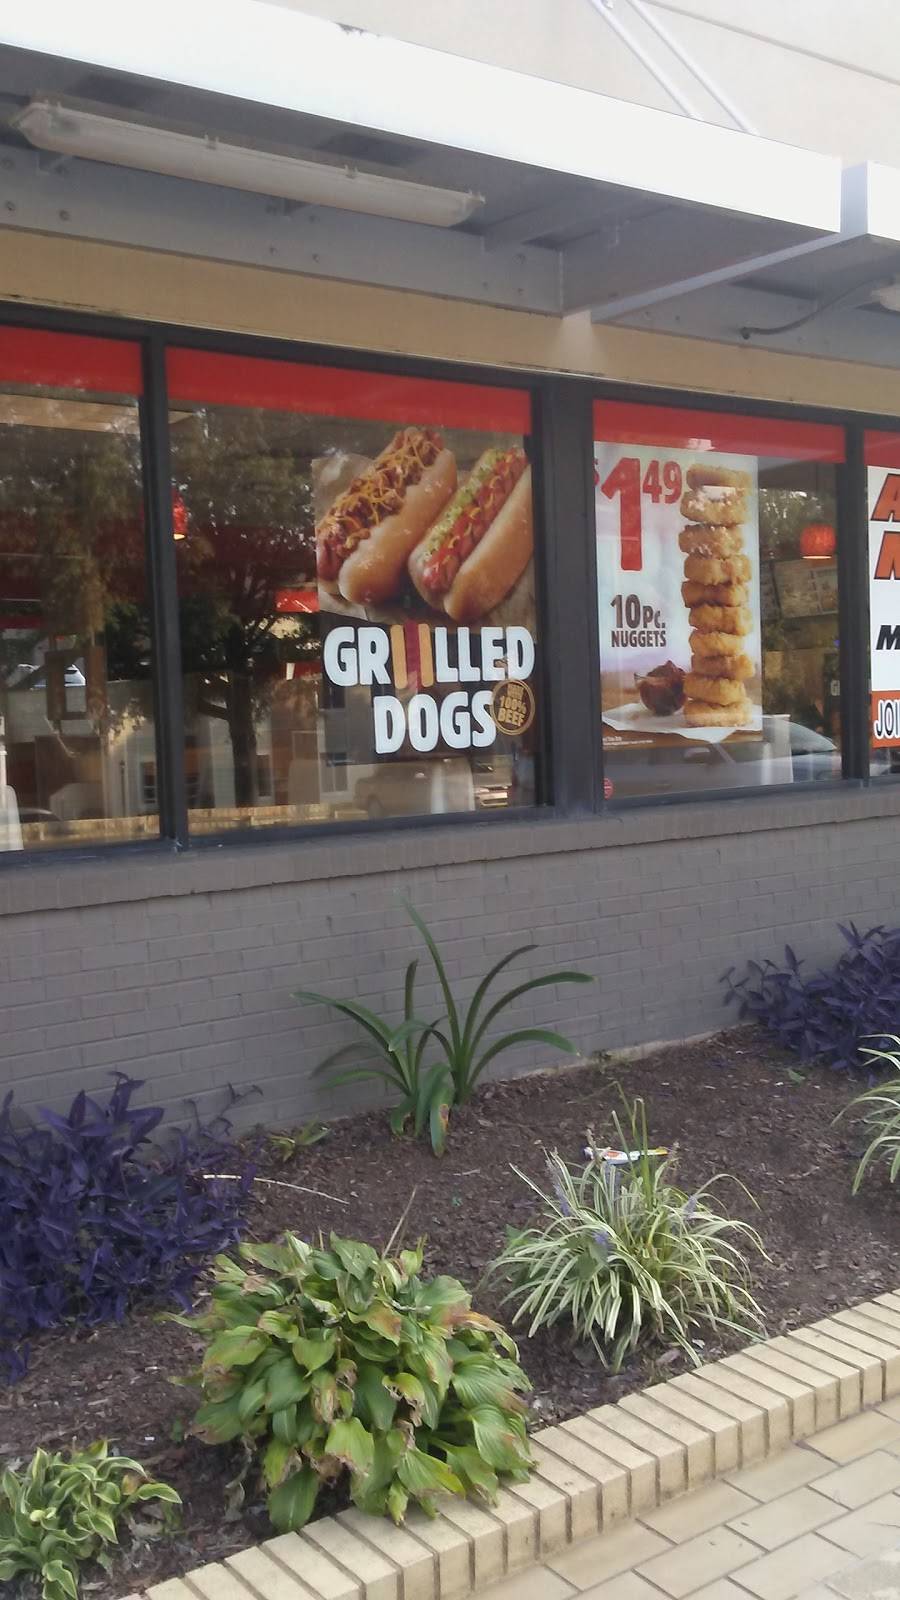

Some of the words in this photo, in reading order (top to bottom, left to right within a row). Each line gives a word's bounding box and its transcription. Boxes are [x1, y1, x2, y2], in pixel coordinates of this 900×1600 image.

[611, 630, 666, 647] NUGGETS
[324, 623, 535, 689] GRILLED
[500, 695, 527, 714] 100%
[373, 690, 497, 754] DOGS
[498, 707, 526, 727] BEEF
